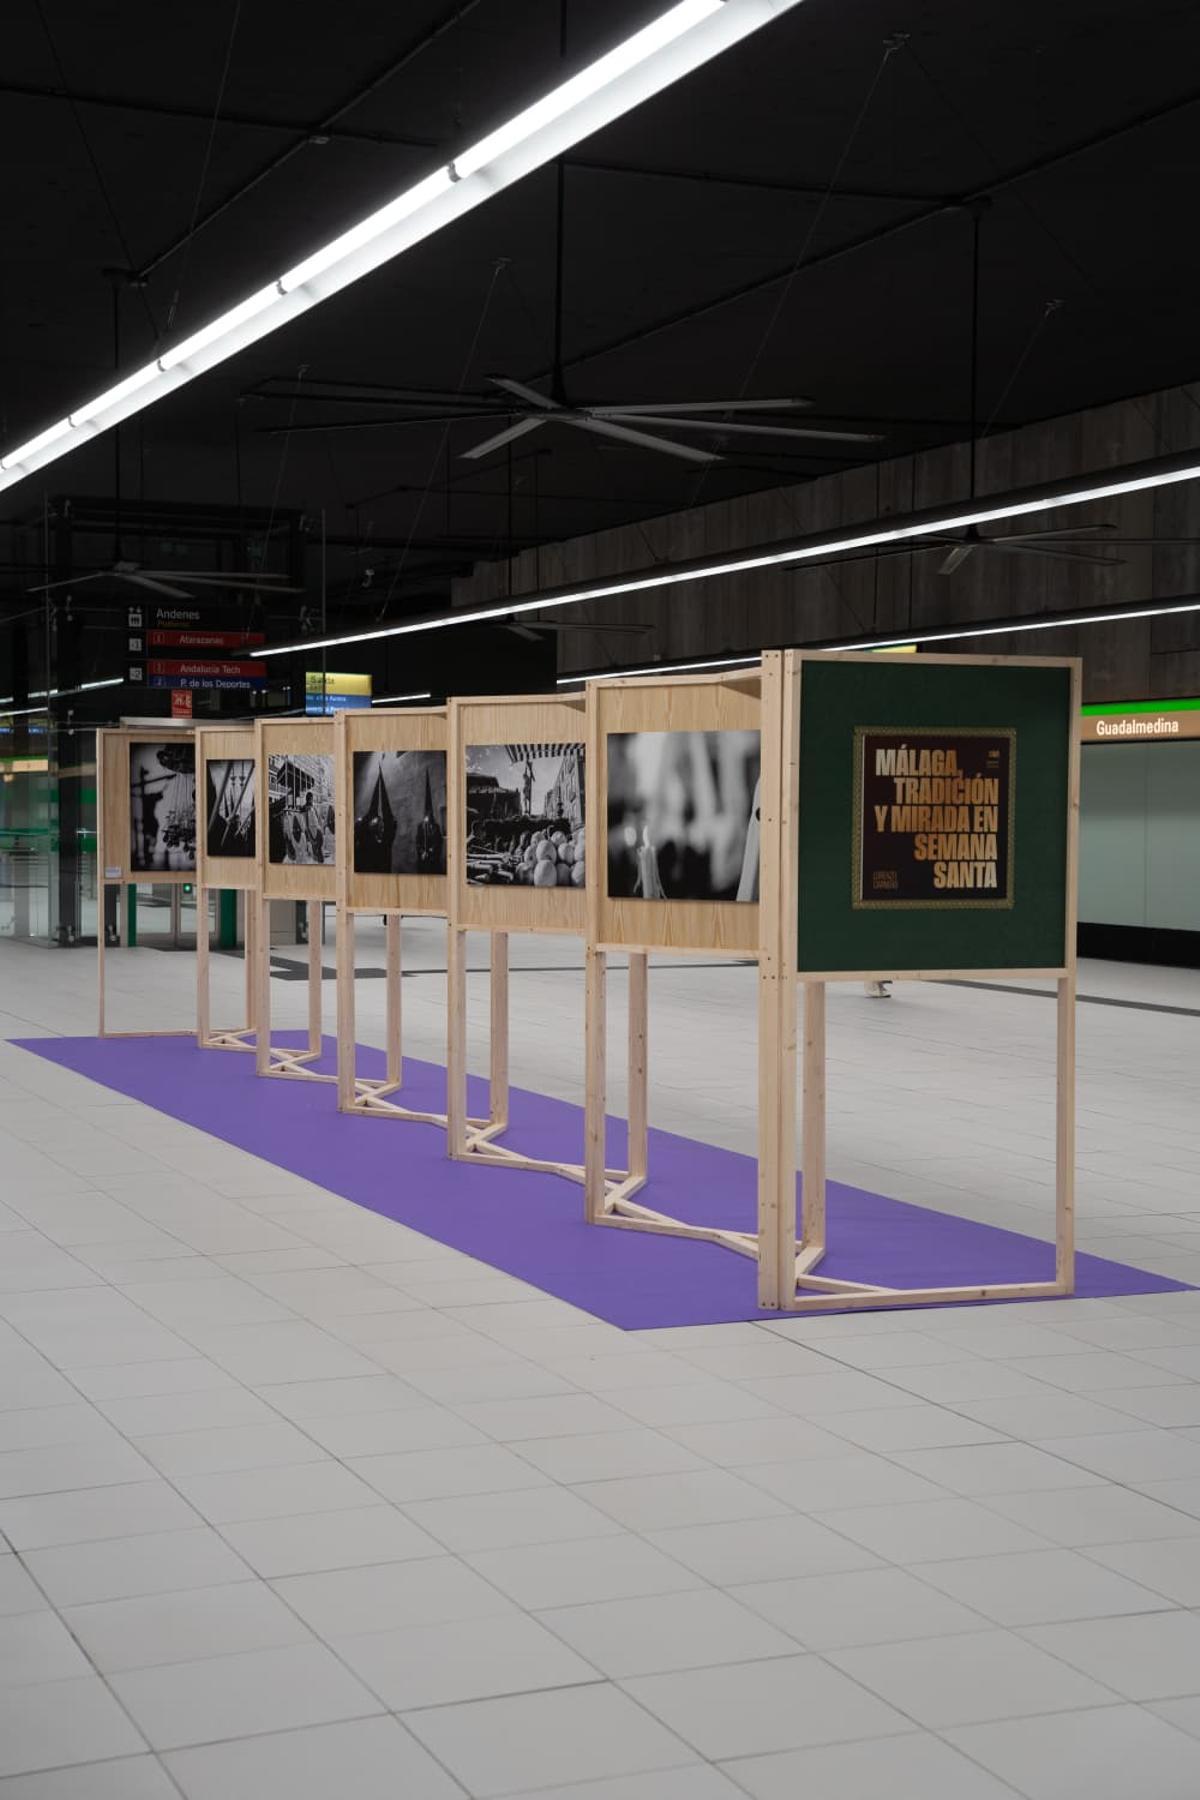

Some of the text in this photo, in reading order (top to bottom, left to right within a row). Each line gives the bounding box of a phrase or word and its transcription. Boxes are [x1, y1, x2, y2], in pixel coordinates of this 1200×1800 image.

[156, 608, 200, 620] Andenes
[223, 664, 241, 674] Tech
[190, 680, 199, 688] de
[202, 680, 213, 688] los
[215, 680, 251, 689] Deportes
[1096, 717, 1179, 736] Guadalmedina
[875, 743, 963, 778] MÁLAGA,
[893, 773, 999, 805] TRADICIÓN
[874, 806, 998, 833] Y MIRADA EN
[914, 834, 997, 860] SEMANA
[933, 861, 997, 889] SANTA
